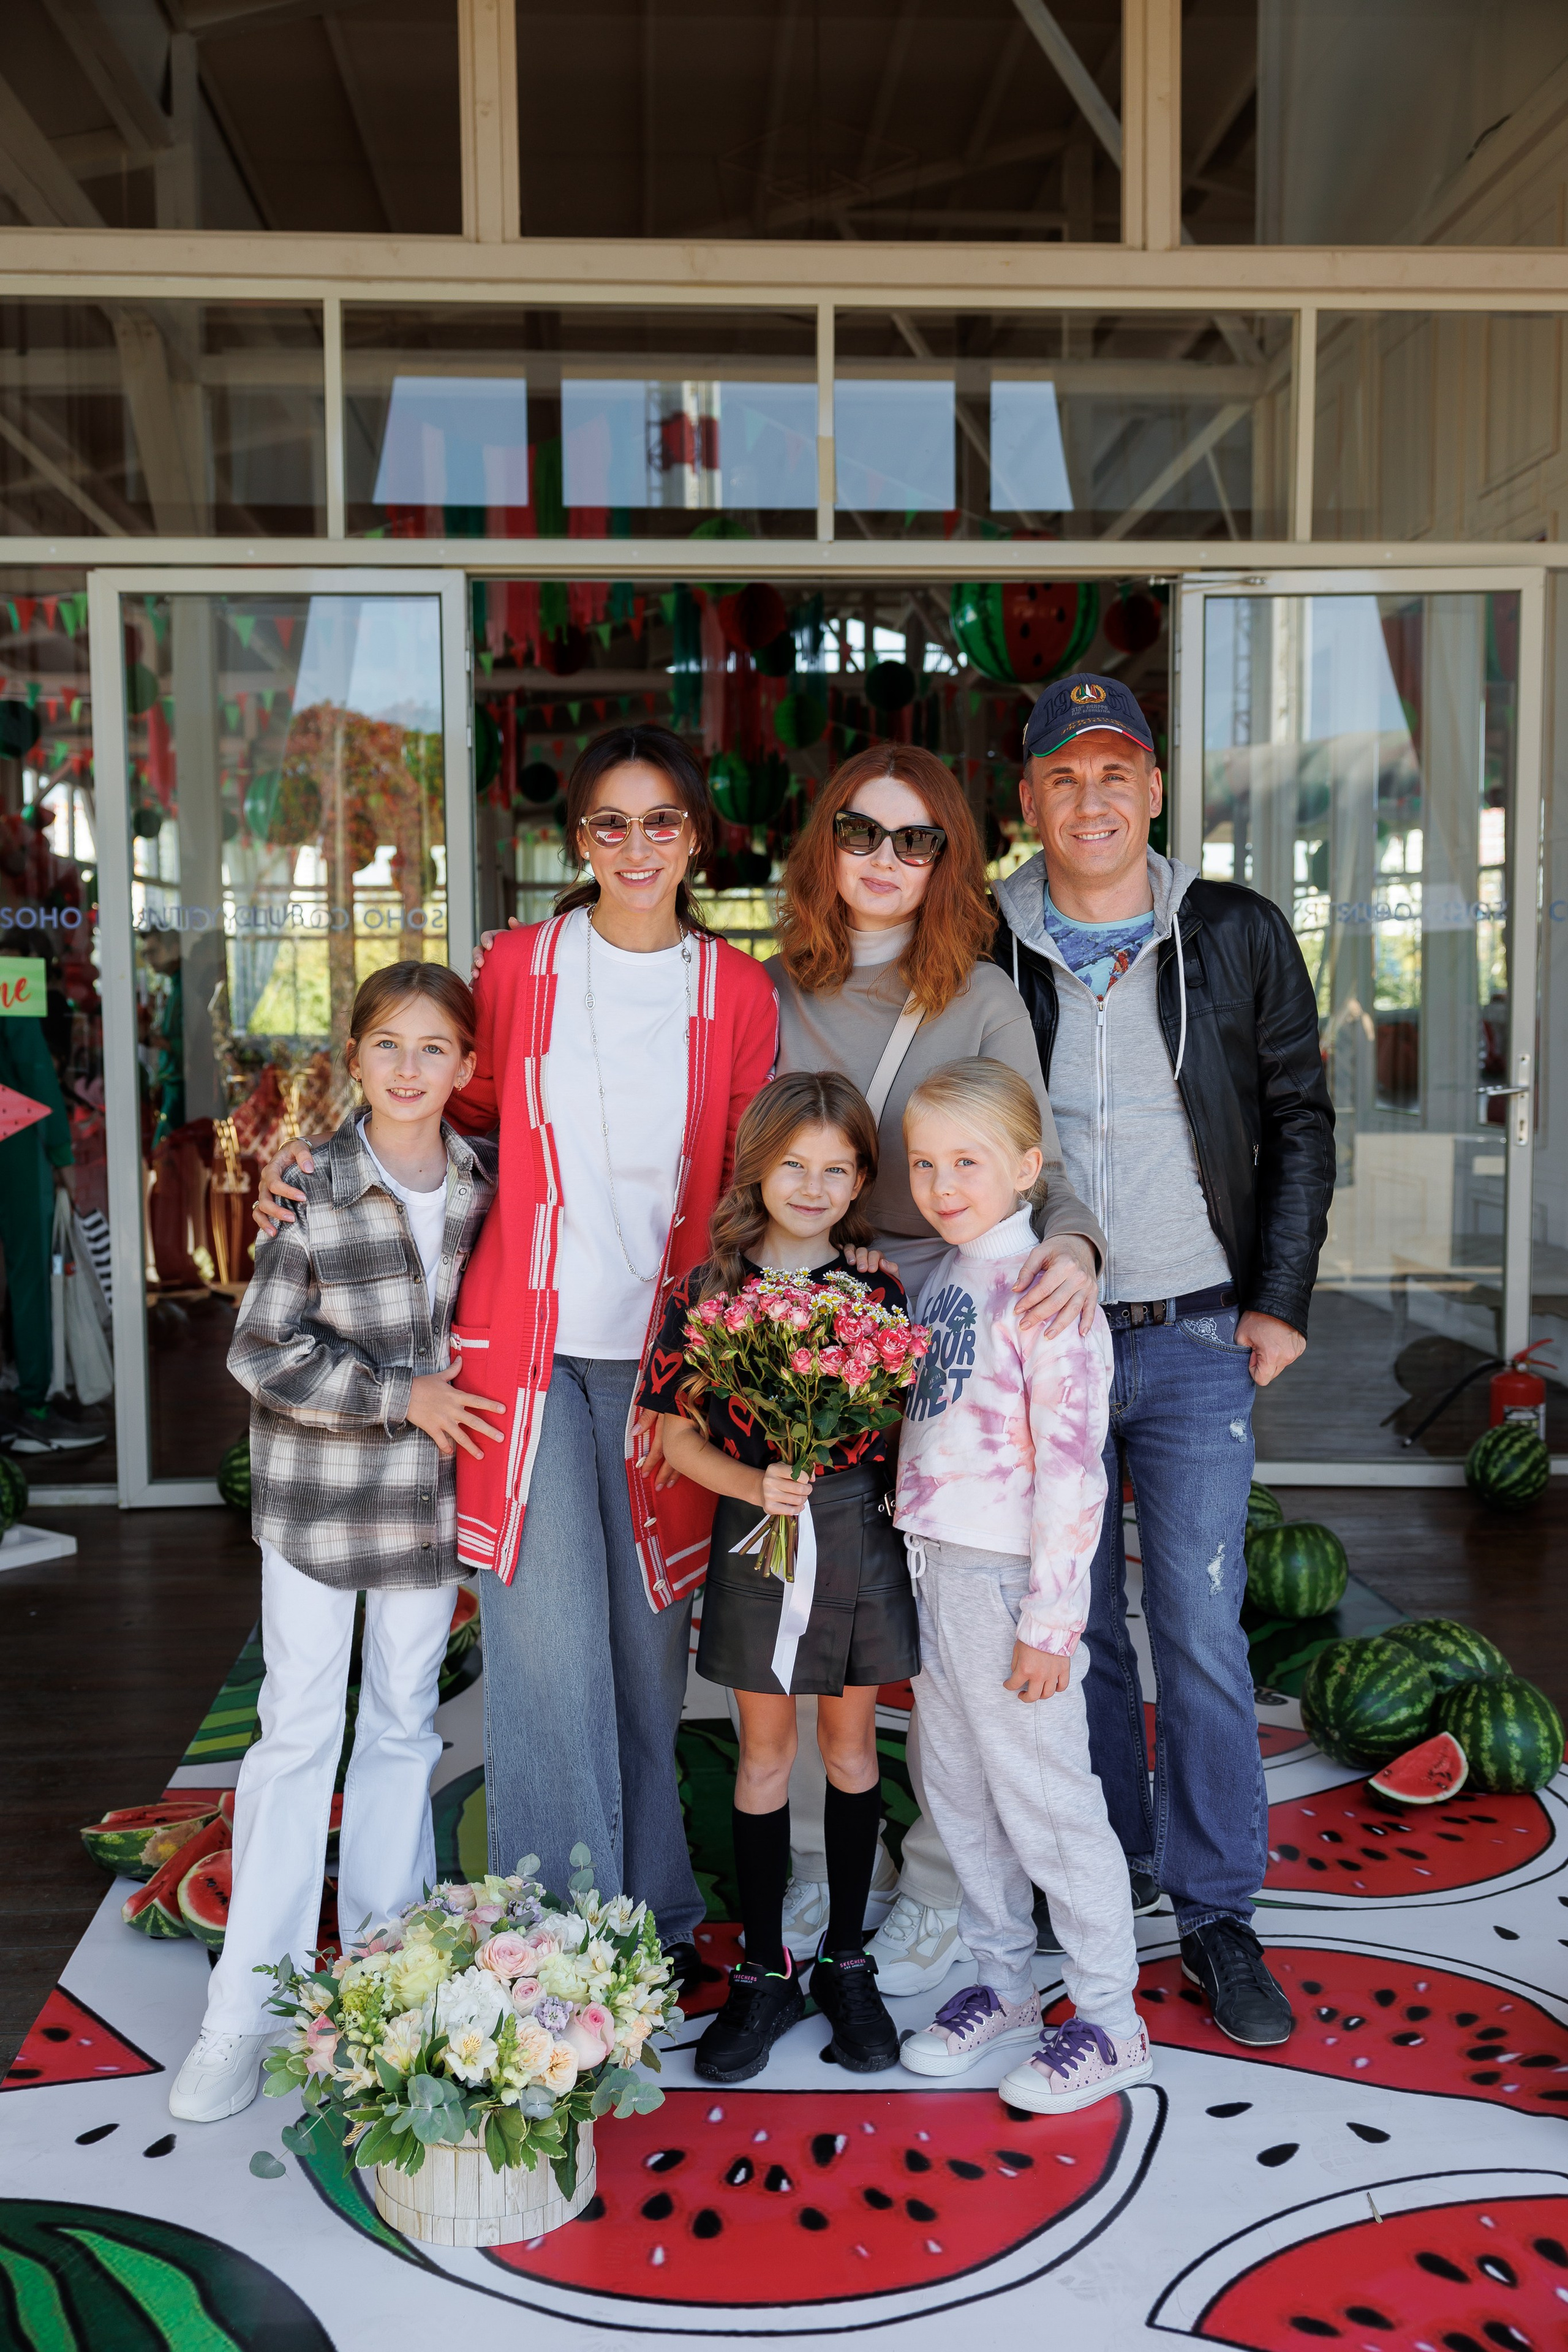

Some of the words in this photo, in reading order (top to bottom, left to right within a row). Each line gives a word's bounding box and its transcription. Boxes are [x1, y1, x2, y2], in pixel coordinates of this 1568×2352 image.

[0, 907, 82, 929] SOHO
[921, 1284, 974, 1332] LOVE
[913, 1329, 976, 1372] OUR
[840, 1959, 866, 1968] SKECHERS
